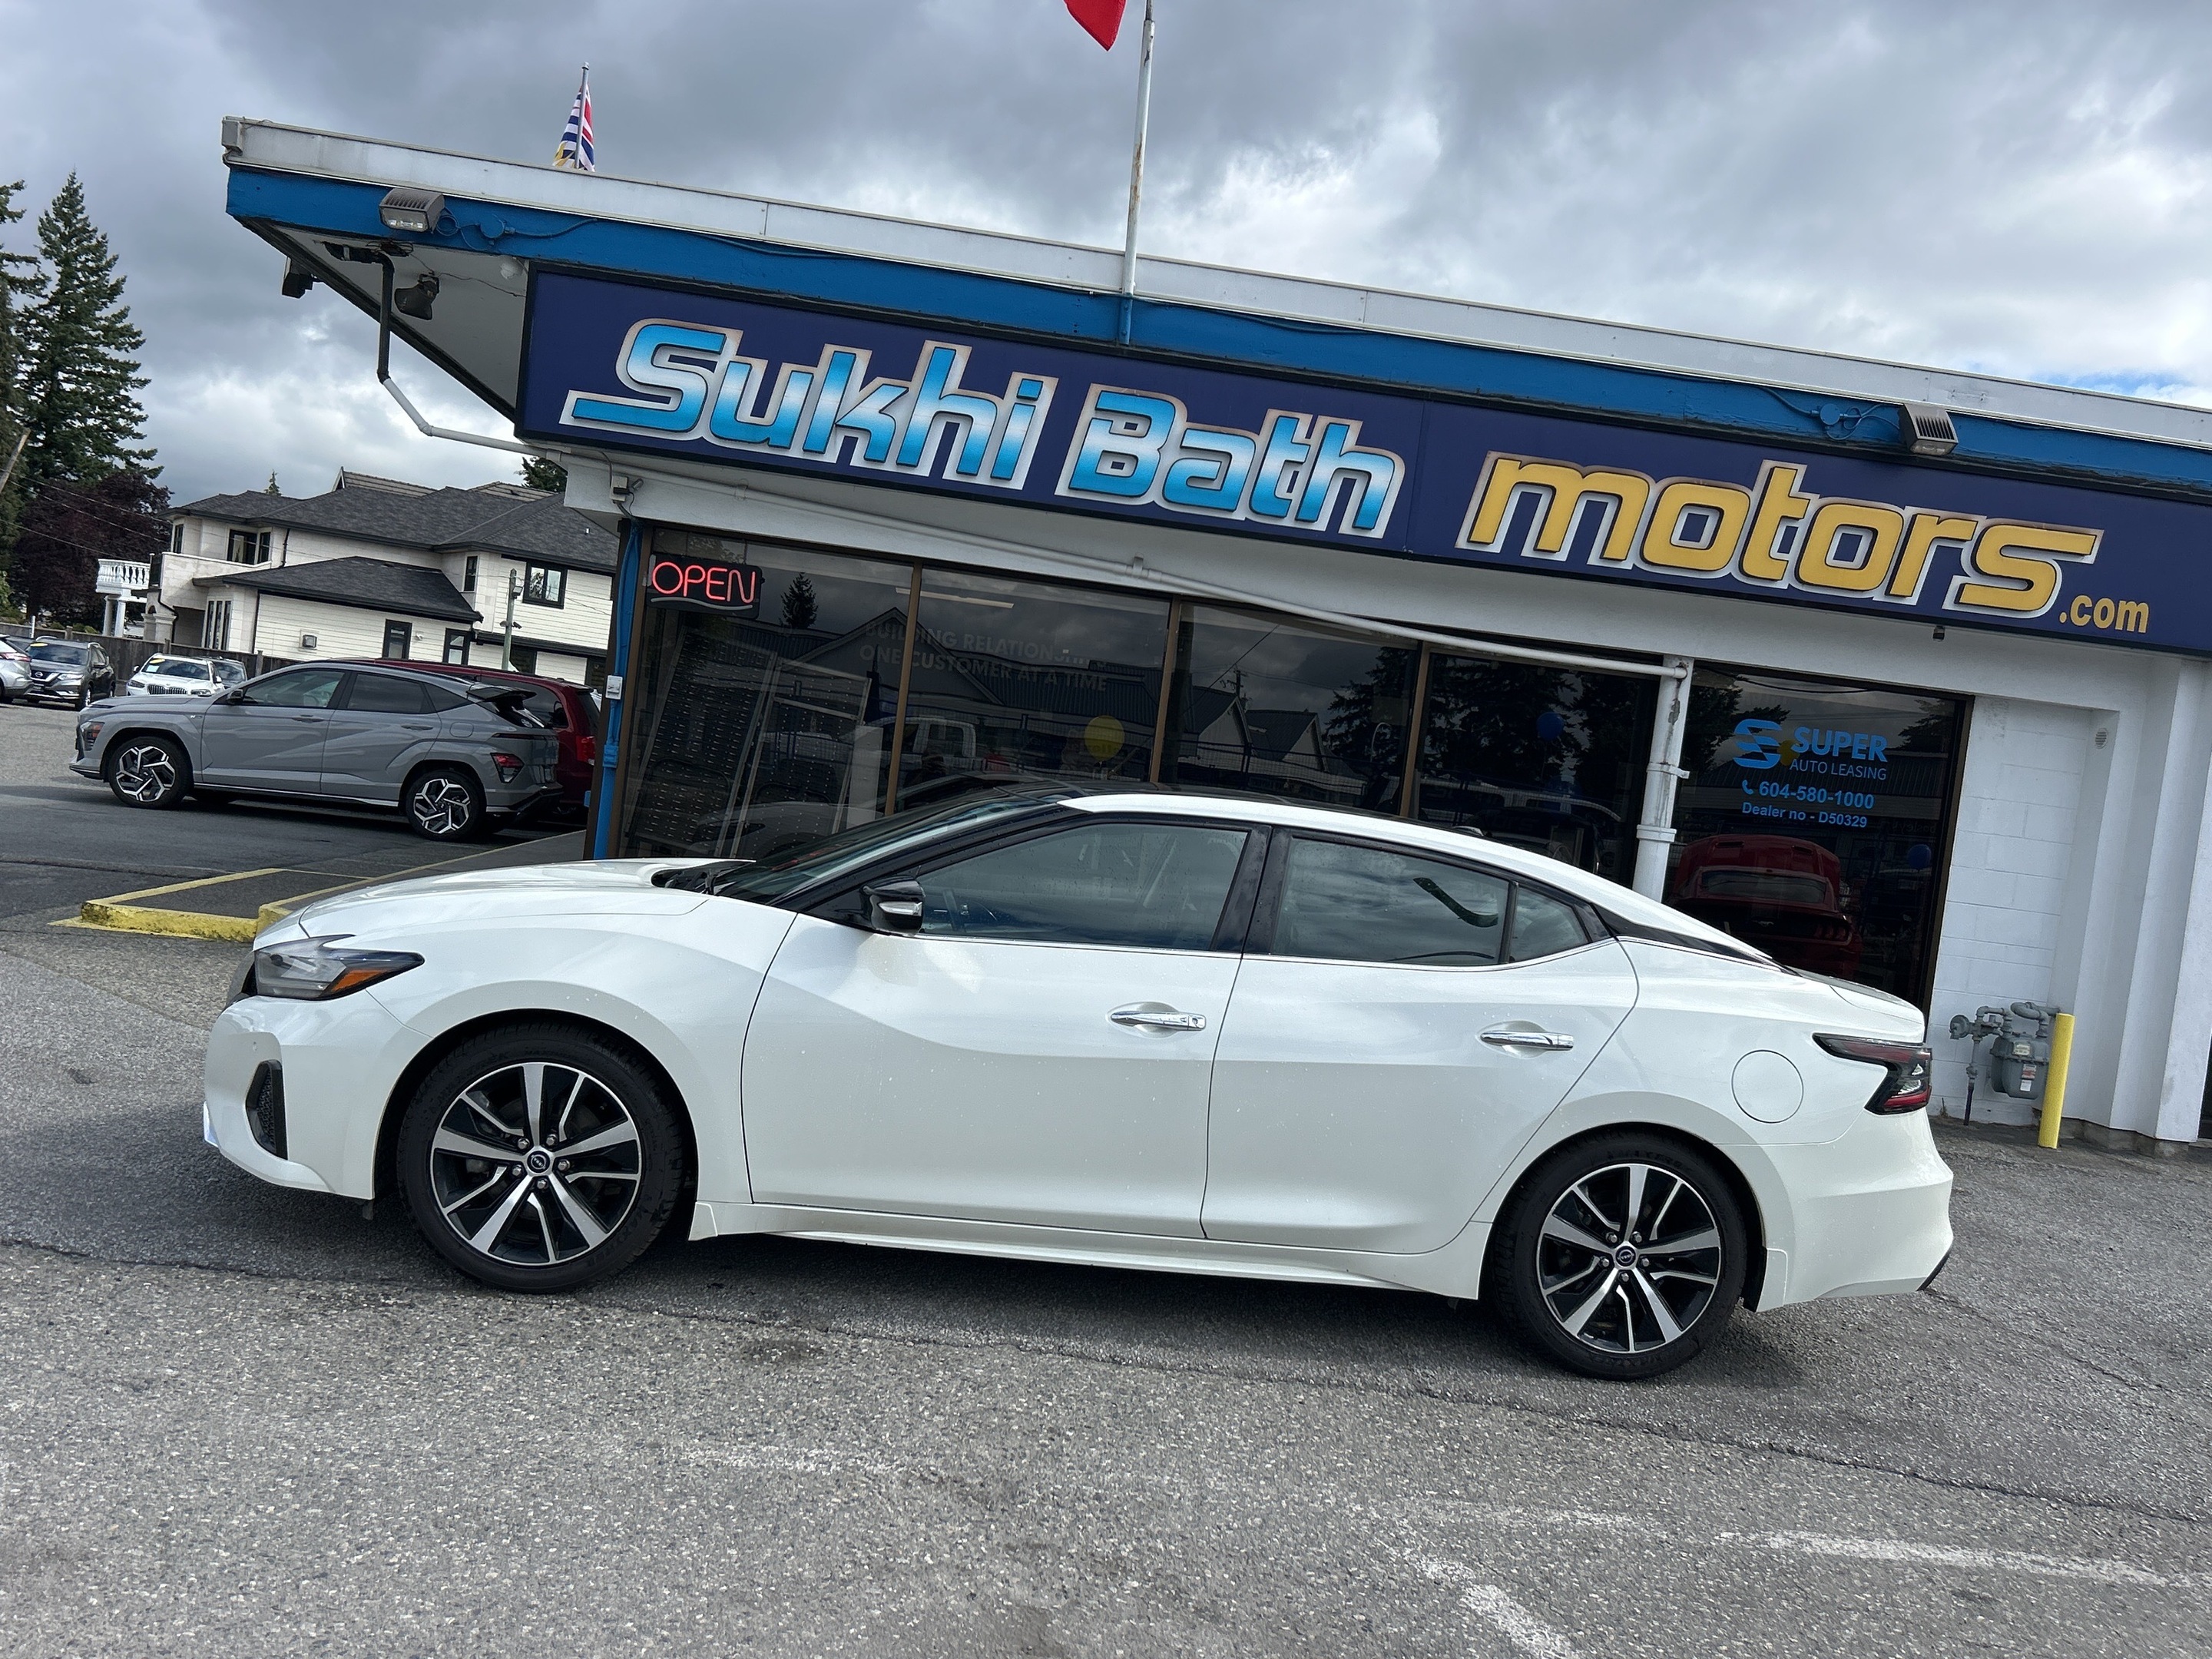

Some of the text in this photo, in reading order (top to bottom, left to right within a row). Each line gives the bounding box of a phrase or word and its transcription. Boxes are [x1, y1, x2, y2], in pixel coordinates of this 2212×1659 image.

[558, 317, 2150, 634] Sukhi Bath motors .com
[652, 561, 756, 604] OPEN
[866, 624, 958, 648] BUILING
[859, 644, 902, 665] ONE
[910, 651, 1012, 680] CUSTOMER
[1018, 667, 1041, 683] AT
[1065, 673, 1108, 691] TIME
[1791, 727, 1888, 763] SUPER
[1790, 759, 1887, 780] AUTO LEASING
[1759, 780, 1875, 810] 604-580-1000
[1742, 802, 1785, 818] Dealer
[1789, 810, 1806, 820] no
[1819, 811, 1868, 828] D50329
